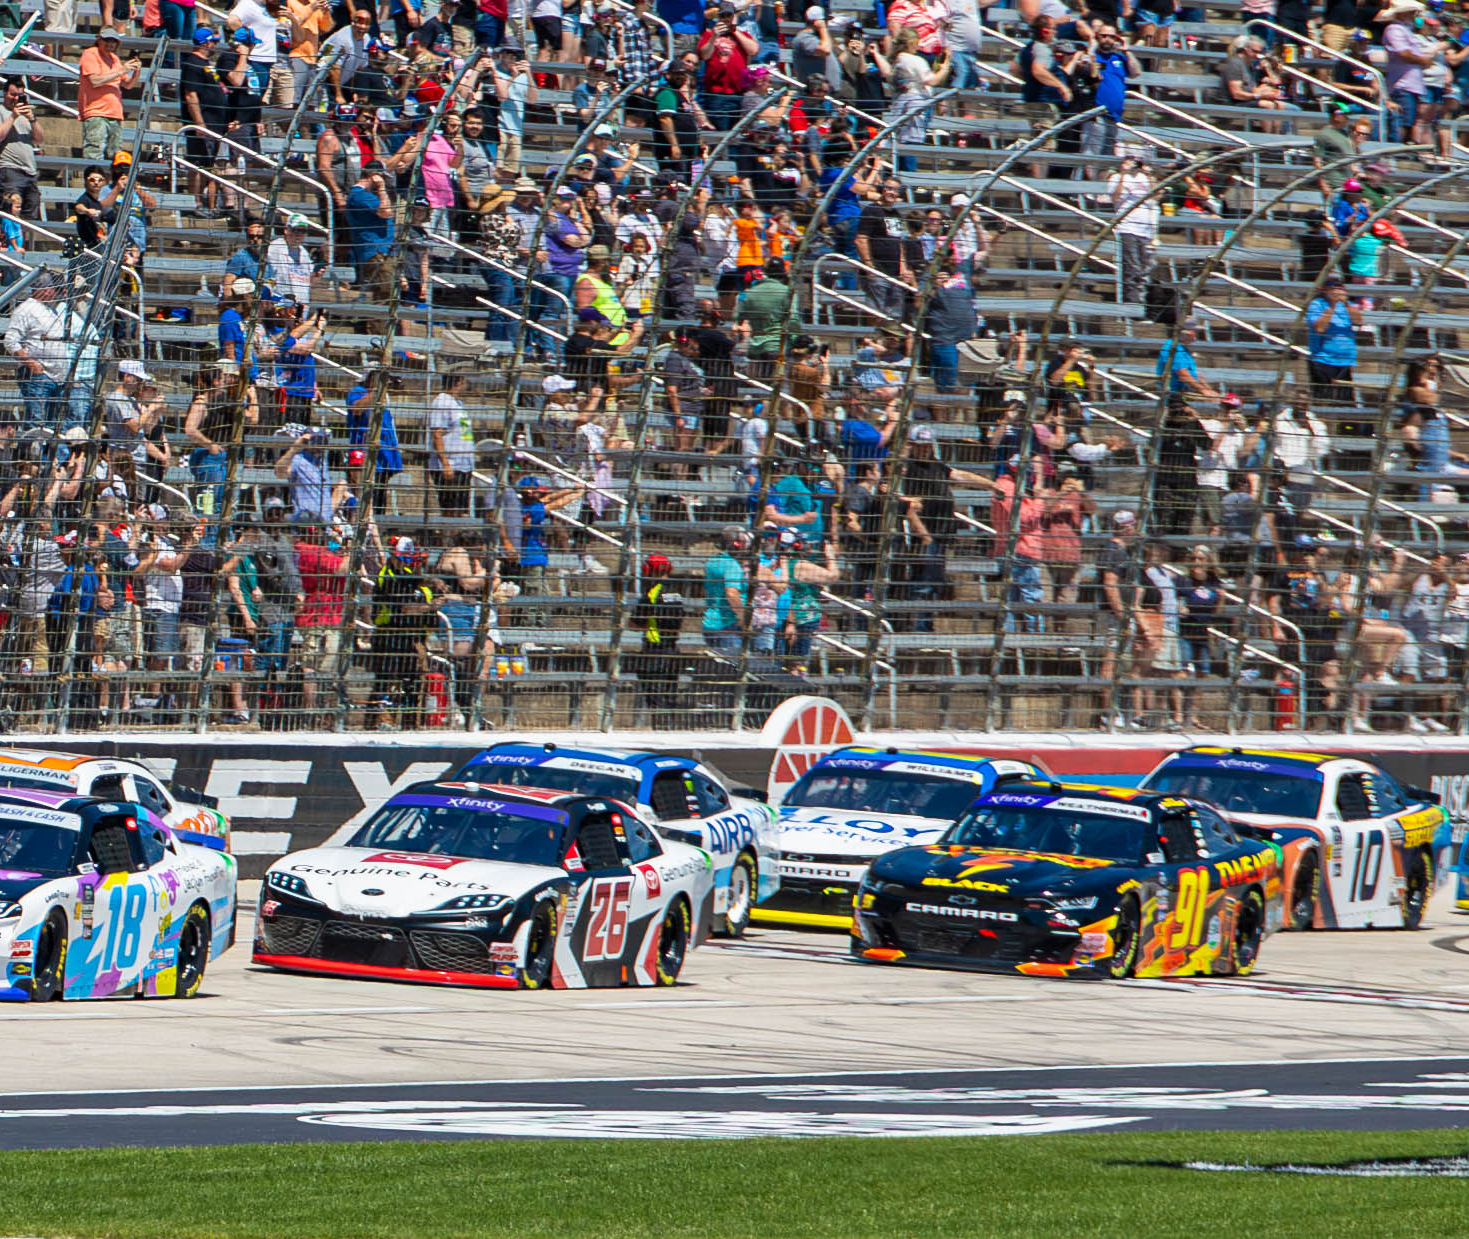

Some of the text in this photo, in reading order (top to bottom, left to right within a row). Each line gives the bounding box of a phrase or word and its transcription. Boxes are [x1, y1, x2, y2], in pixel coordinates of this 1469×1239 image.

[483, 754, 626, 774] xfinity DEEGAN
[825, 758, 975, 778] xfinity WILLIAMS
[1216, 758, 1269, 771] xfinity
[446, 797, 505, 812] xfinity
[990, 794, 1043, 806] xfinity
[34, 811, 65, 823] CASH
[781, 812, 944, 839] LLOY
[778, 864, 851, 879] MARO
[1347, 829, 1385, 903] 10
[290, 863, 490, 892] Genuine Parts
[905, 902, 1019, 922] CAMARO
[1170, 864, 1211, 950] 91
[101, 883, 147, 972] 18
[582, 874, 637, 963] 26
